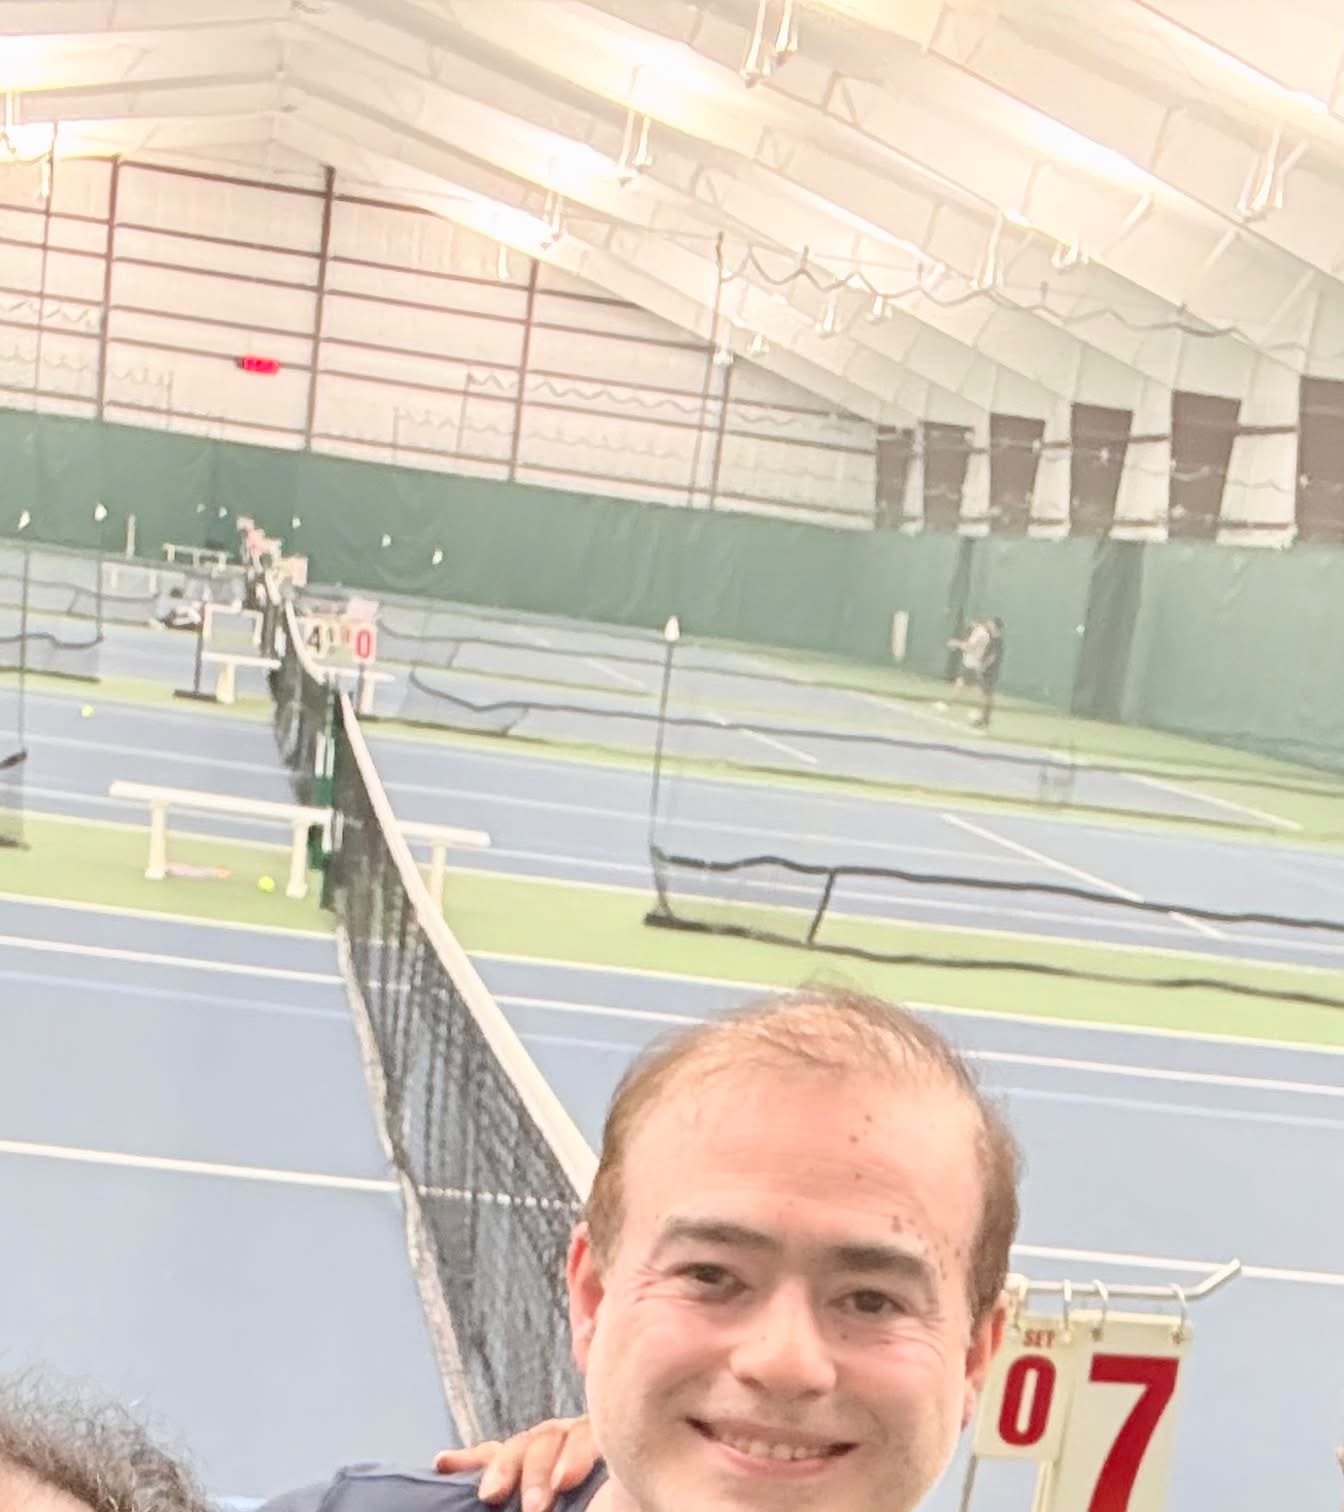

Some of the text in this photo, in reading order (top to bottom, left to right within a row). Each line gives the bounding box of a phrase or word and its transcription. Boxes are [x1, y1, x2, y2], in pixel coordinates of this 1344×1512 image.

[305, 625, 321, 654] 4
[356, 629, 371, 659] 0
[1023, 1328, 1056, 1349] SET
[998, 1354, 1057, 1446] 0
